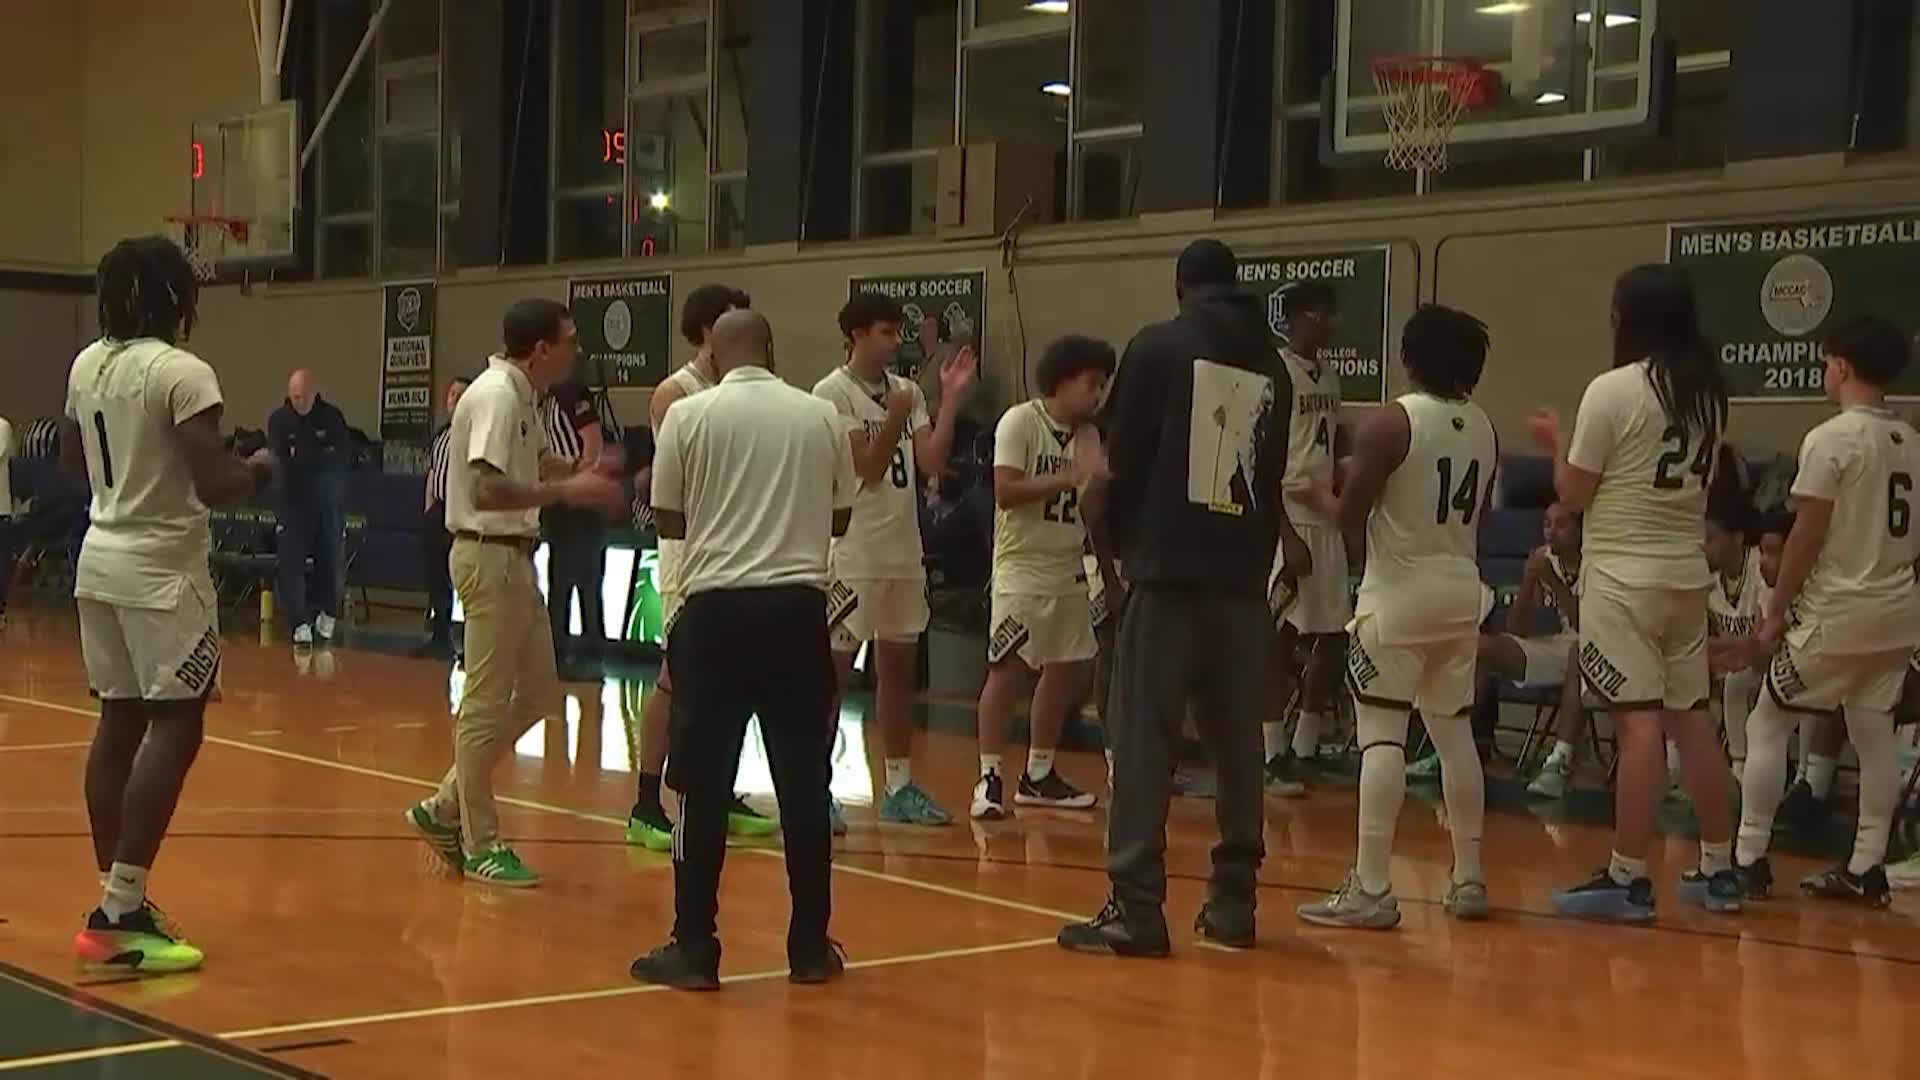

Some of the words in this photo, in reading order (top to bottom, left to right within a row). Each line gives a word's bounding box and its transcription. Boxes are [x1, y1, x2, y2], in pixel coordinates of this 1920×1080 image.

[1680, 232, 1753, 255] MEN'S
[1286, 259, 1355, 279] SOCCER
[604, 280, 667, 297] BASKETBALL
[920, 279, 972, 296] SOCCER
[1720, 342, 1824, 364] CHAMPI
[1764, 368, 1823, 389] 2018
[93, 410, 113, 489] 1
[1437, 457, 1480, 526] 14
[1888, 472, 1912, 538] 6
[1582, 641, 1627, 697] BRISTOL
